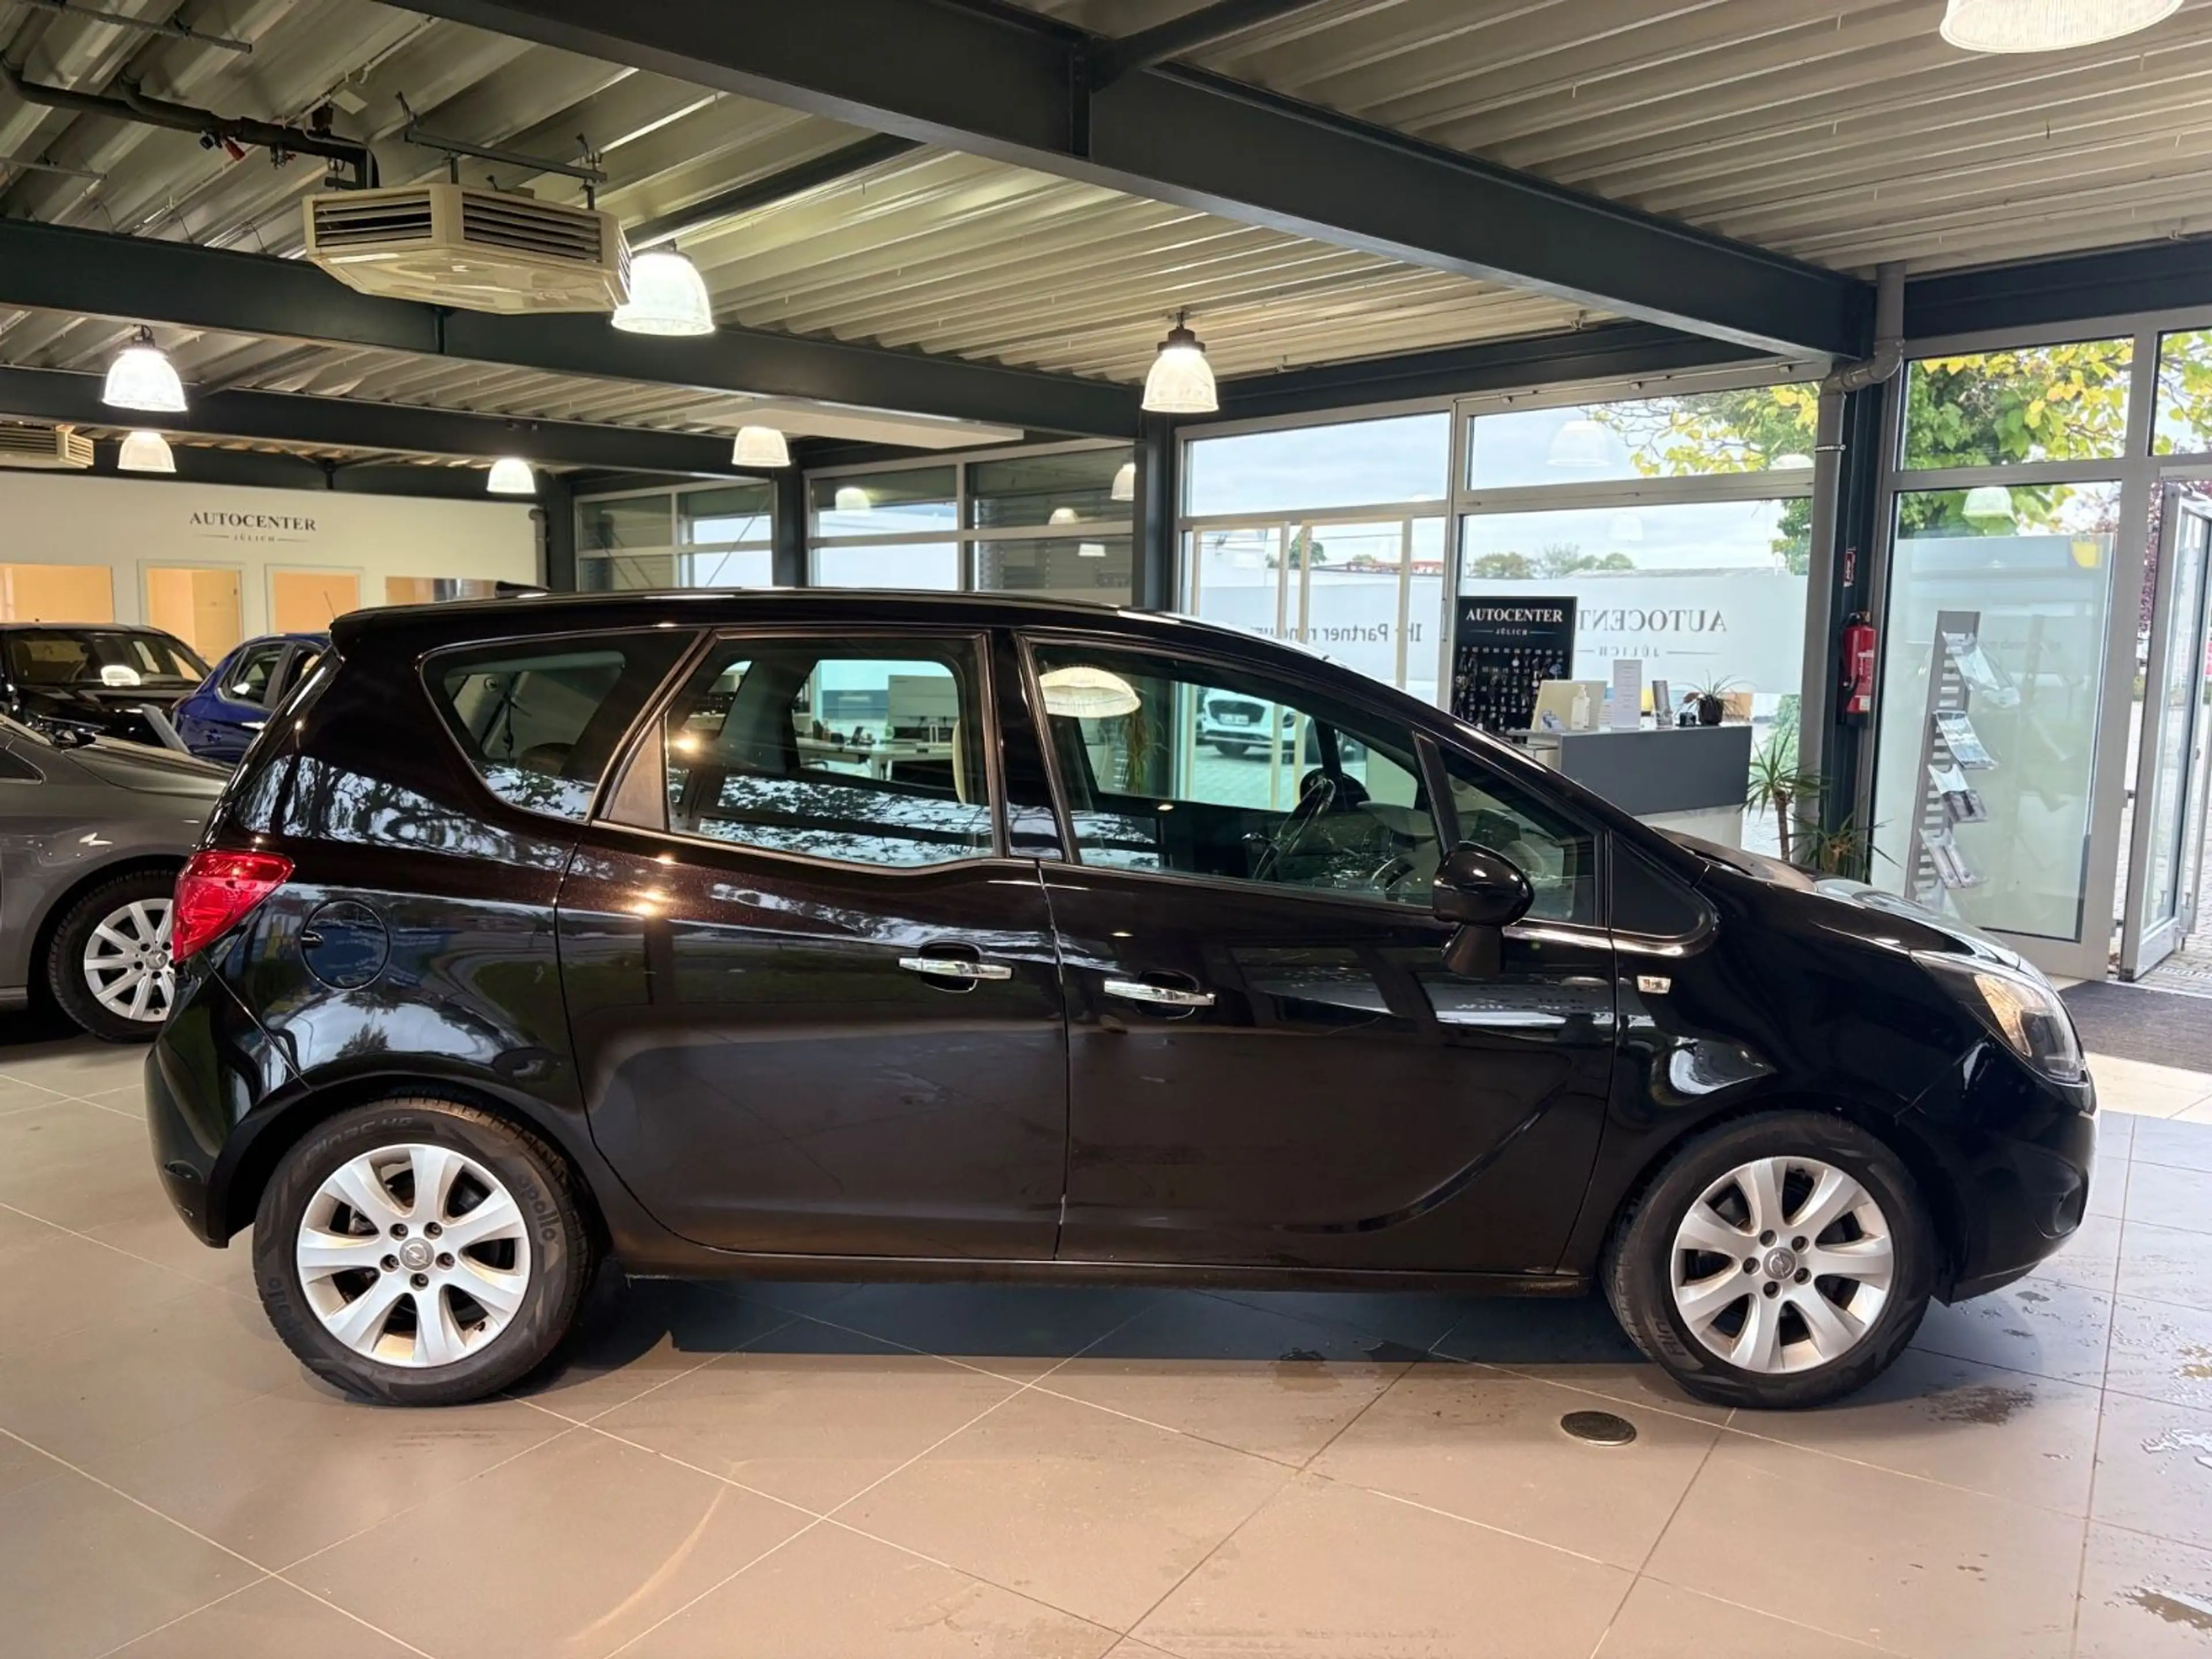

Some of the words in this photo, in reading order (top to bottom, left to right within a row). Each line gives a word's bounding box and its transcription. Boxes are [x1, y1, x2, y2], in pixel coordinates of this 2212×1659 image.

[190, 512, 316, 531] AUTOCENTER
[1466, 608, 1563, 623] AUTOCENTER
[516, 1173, 561, 1241] apollo
